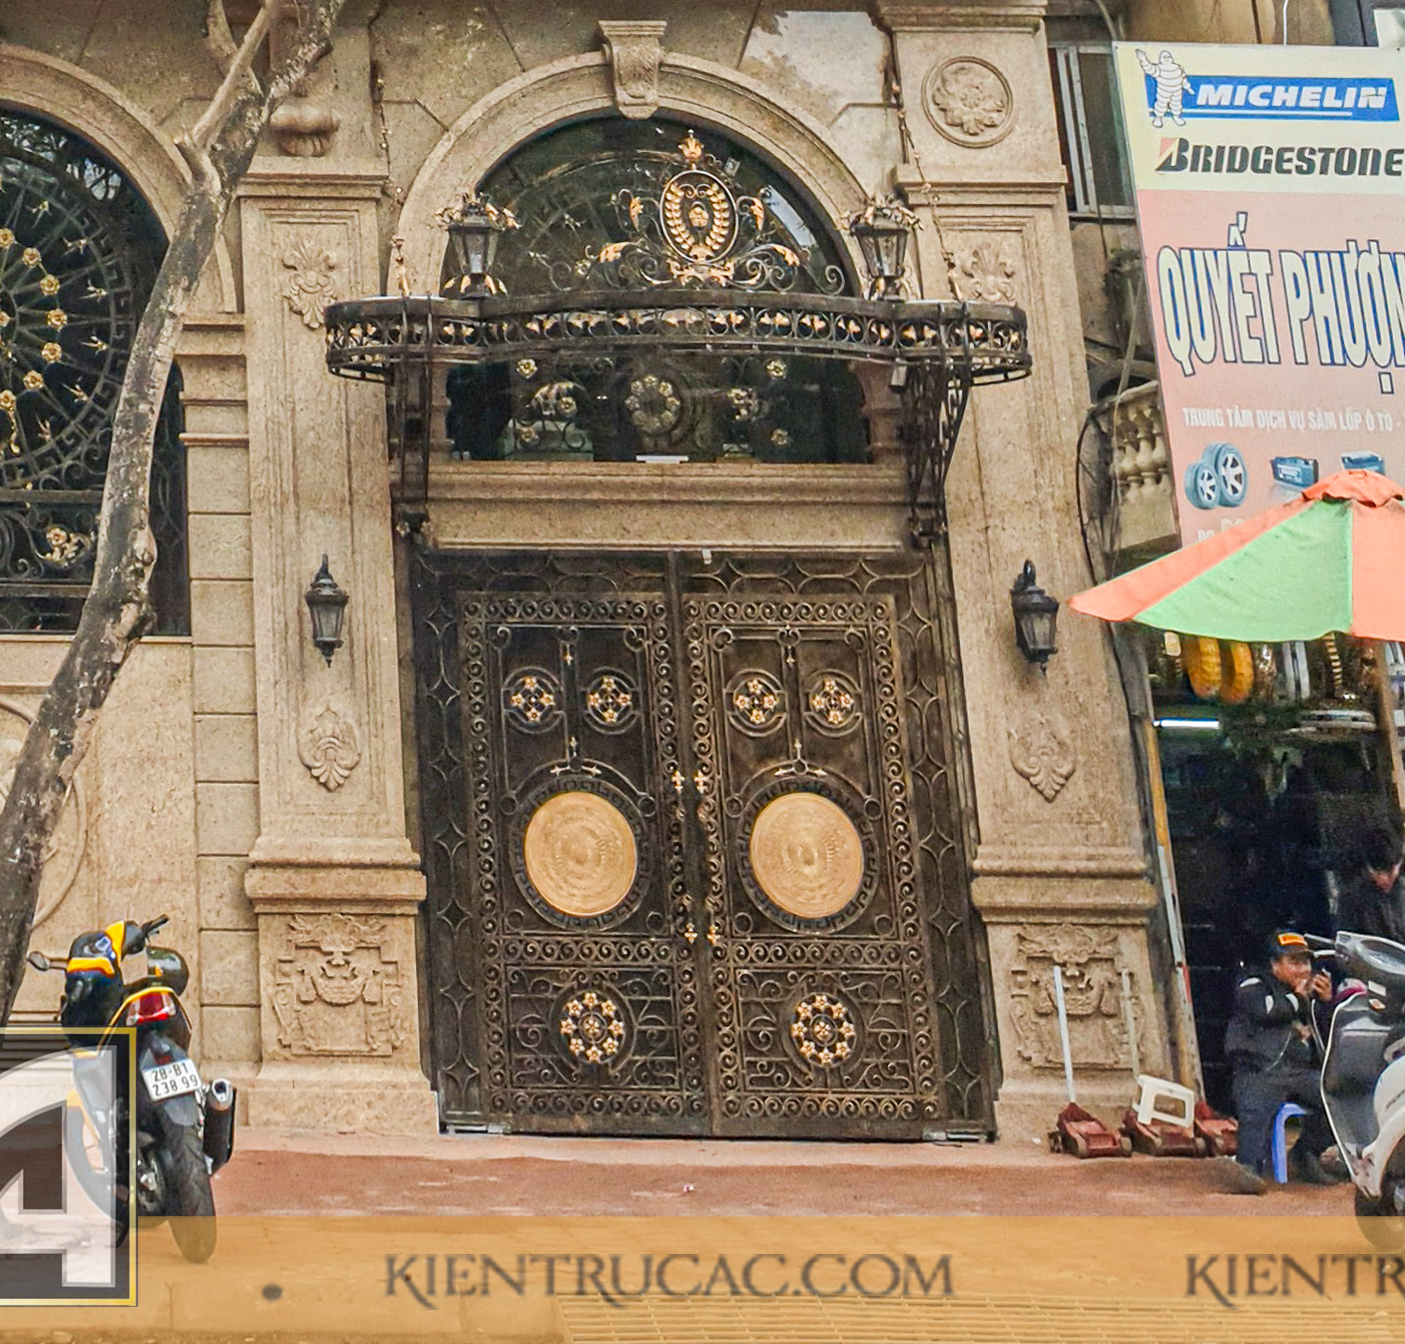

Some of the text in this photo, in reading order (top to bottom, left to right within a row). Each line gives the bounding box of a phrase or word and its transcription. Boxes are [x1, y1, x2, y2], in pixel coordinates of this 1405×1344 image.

[1196, 84, 1388, 109] MICHELIN
[1155, 137, 1405, 177] BRIDGESTONE
[1157, 211, 1281, 378] QUYẾT
[1182, 407, 1224, 427] TRUNG
[1226, 405, 1254, 428] TÂM
[1256, 410, 1286, 433] DỊCH
[1289, 410, 1305, 433] VỤ
[1339, 406, 1361, 431] LỐP
